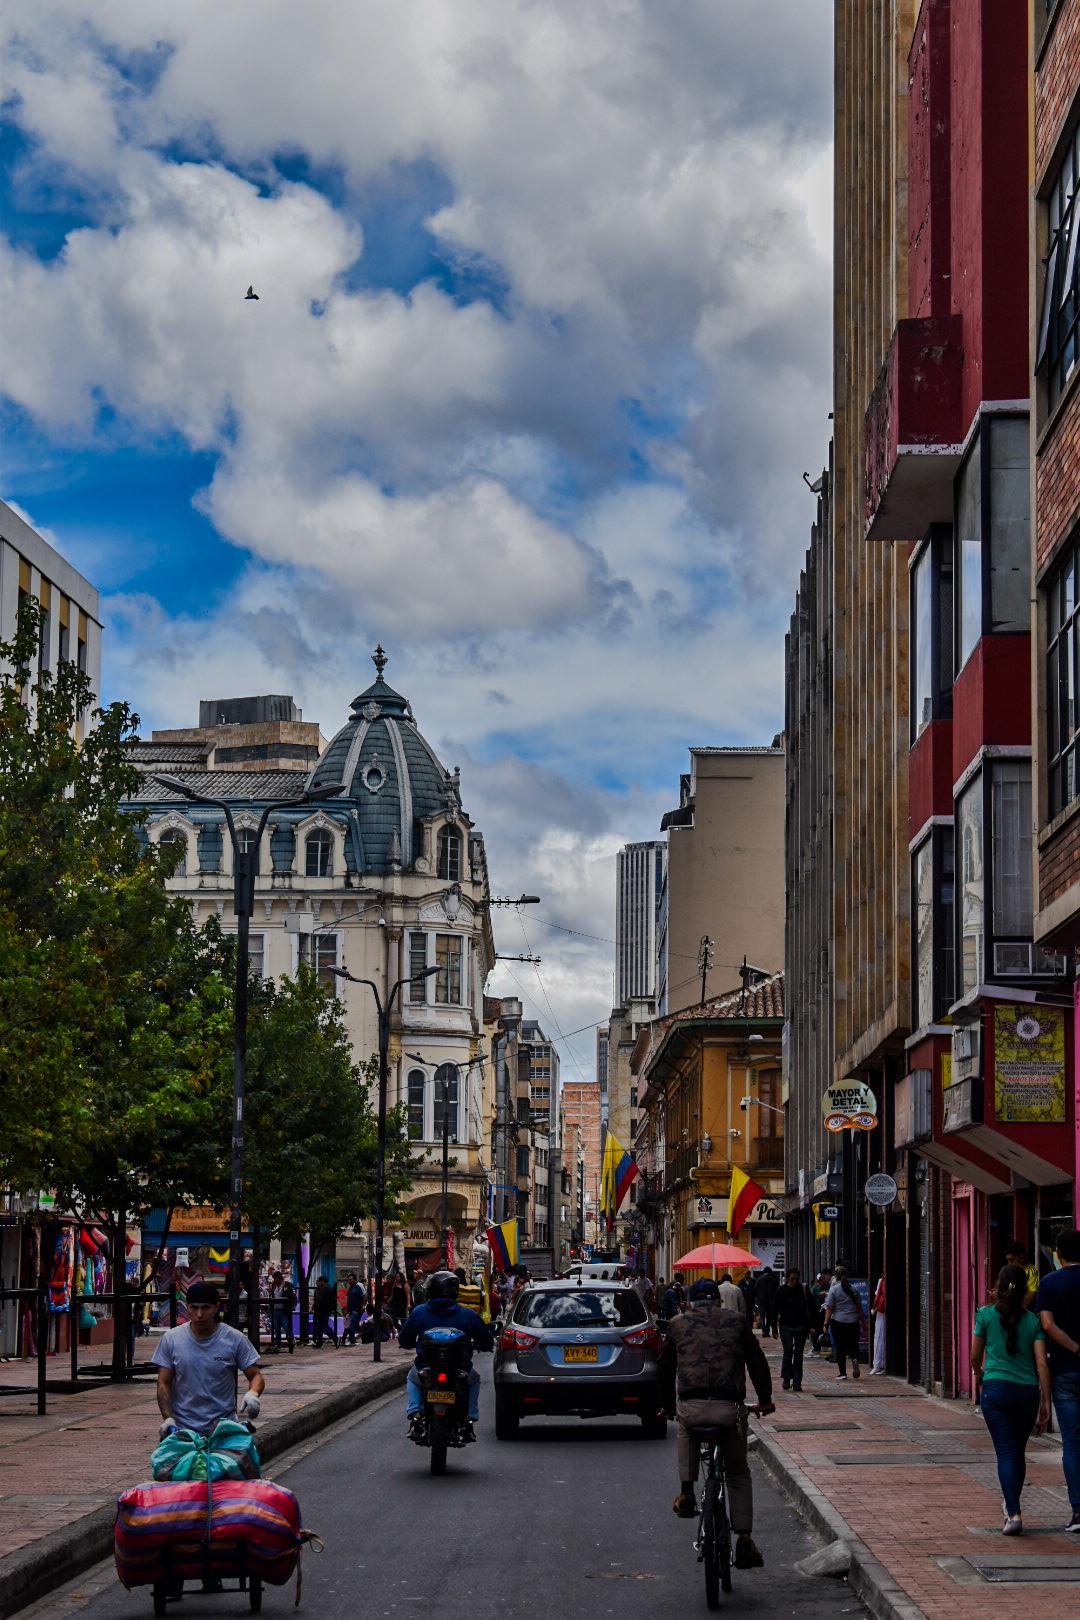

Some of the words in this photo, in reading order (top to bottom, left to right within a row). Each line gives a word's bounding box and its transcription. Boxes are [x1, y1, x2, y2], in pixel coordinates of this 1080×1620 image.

[828, 1088, 861, 1098] MAYOR
[863, 1087, 870, 1096] Y
[832, 1097, 867, 1106] DETAL
